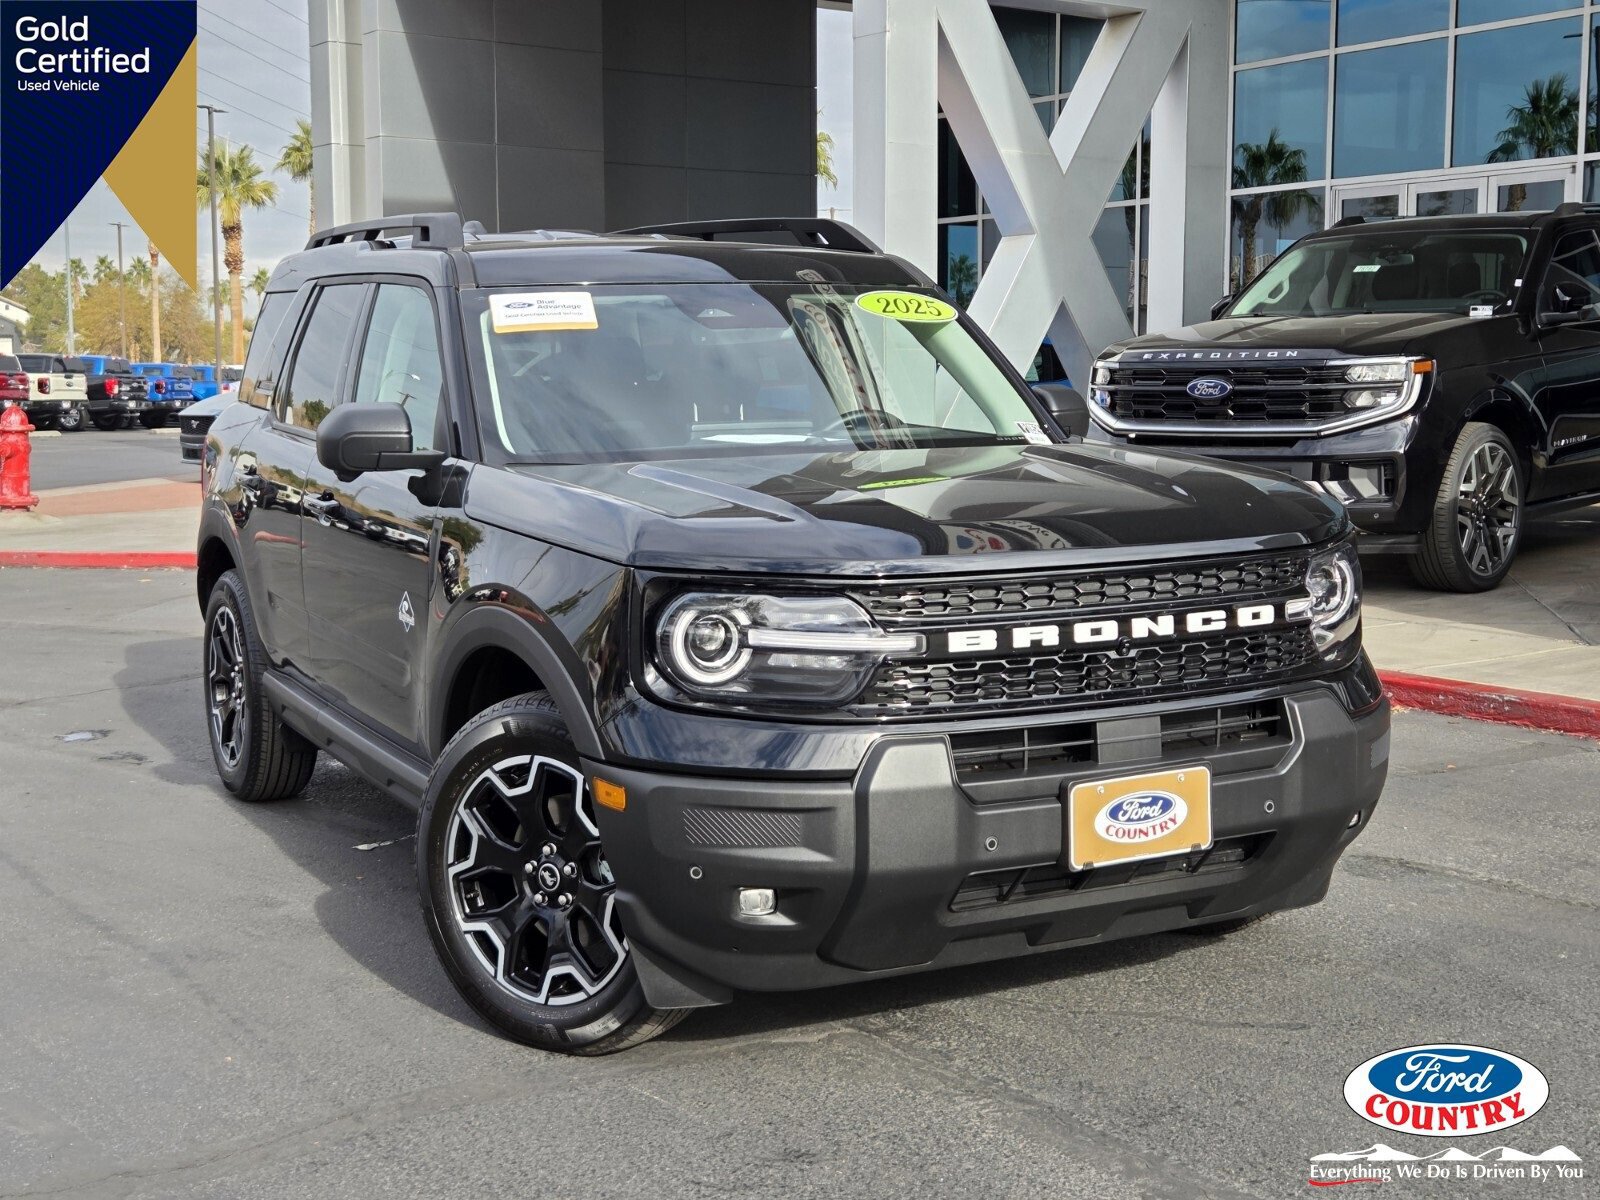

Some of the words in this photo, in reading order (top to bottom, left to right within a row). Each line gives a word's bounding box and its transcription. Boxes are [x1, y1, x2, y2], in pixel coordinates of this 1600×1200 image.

[877, 297, 942, 317] 2025
[1143, 350, 1298, 360] EXPEDITION
[1194, 381, 1221, 396] Ford
[948, 604, 1275, 653] BRONCO
[1118, 797, 1164, 822] Ford
[1105, 813, 1179, 840] COUNTRY
